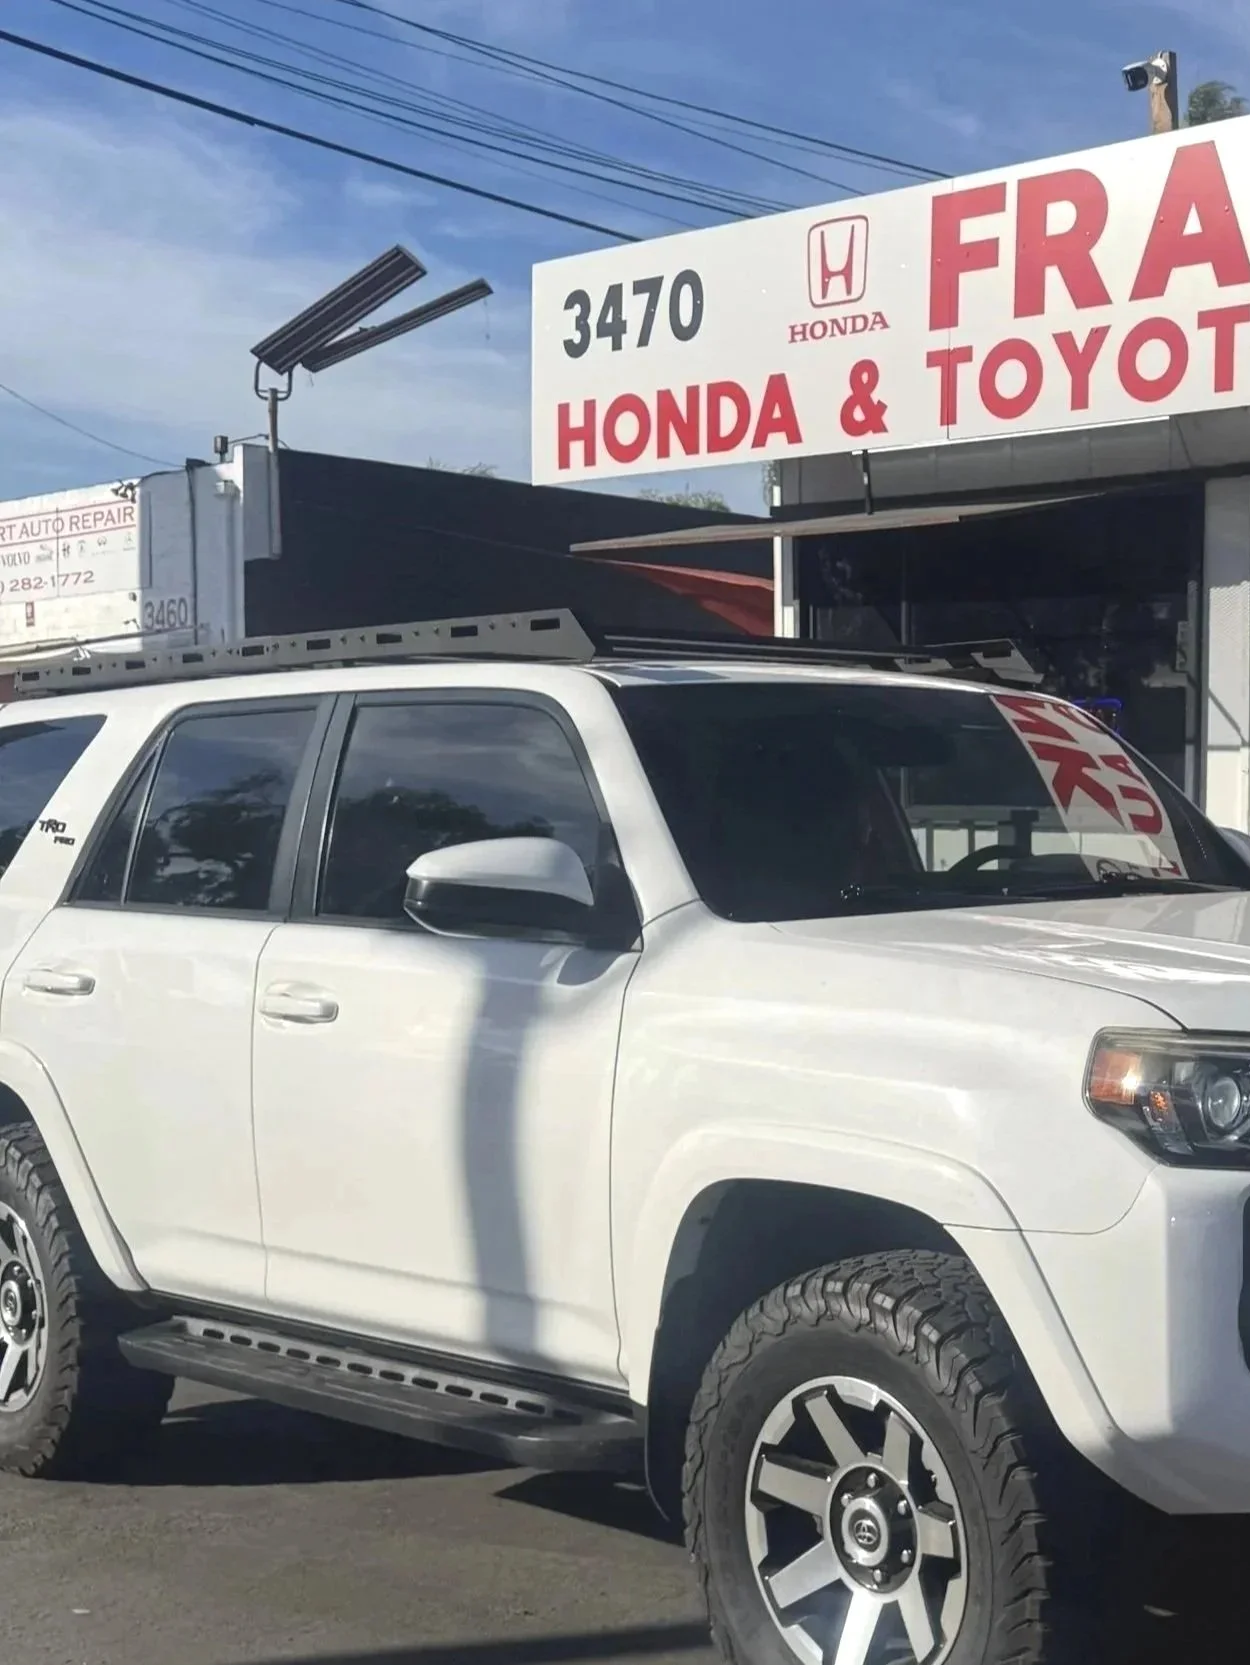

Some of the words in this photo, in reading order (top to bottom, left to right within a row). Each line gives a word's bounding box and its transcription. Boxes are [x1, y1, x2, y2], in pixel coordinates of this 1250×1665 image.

[562, 268, 705, 359] 3470
[788, 311, 891, 344] HONDA
[557, 373, 804, 470] HONDA
[839, 359, 889, 438] &
[19, 517, 65, 539] AUTO
[69, 506, 135, 532] REPAIR
[1, 551, 31, 567] VOLVO
[9, 570, 96, 593] 282-1772
[144, 597, 188, 630] 3460
